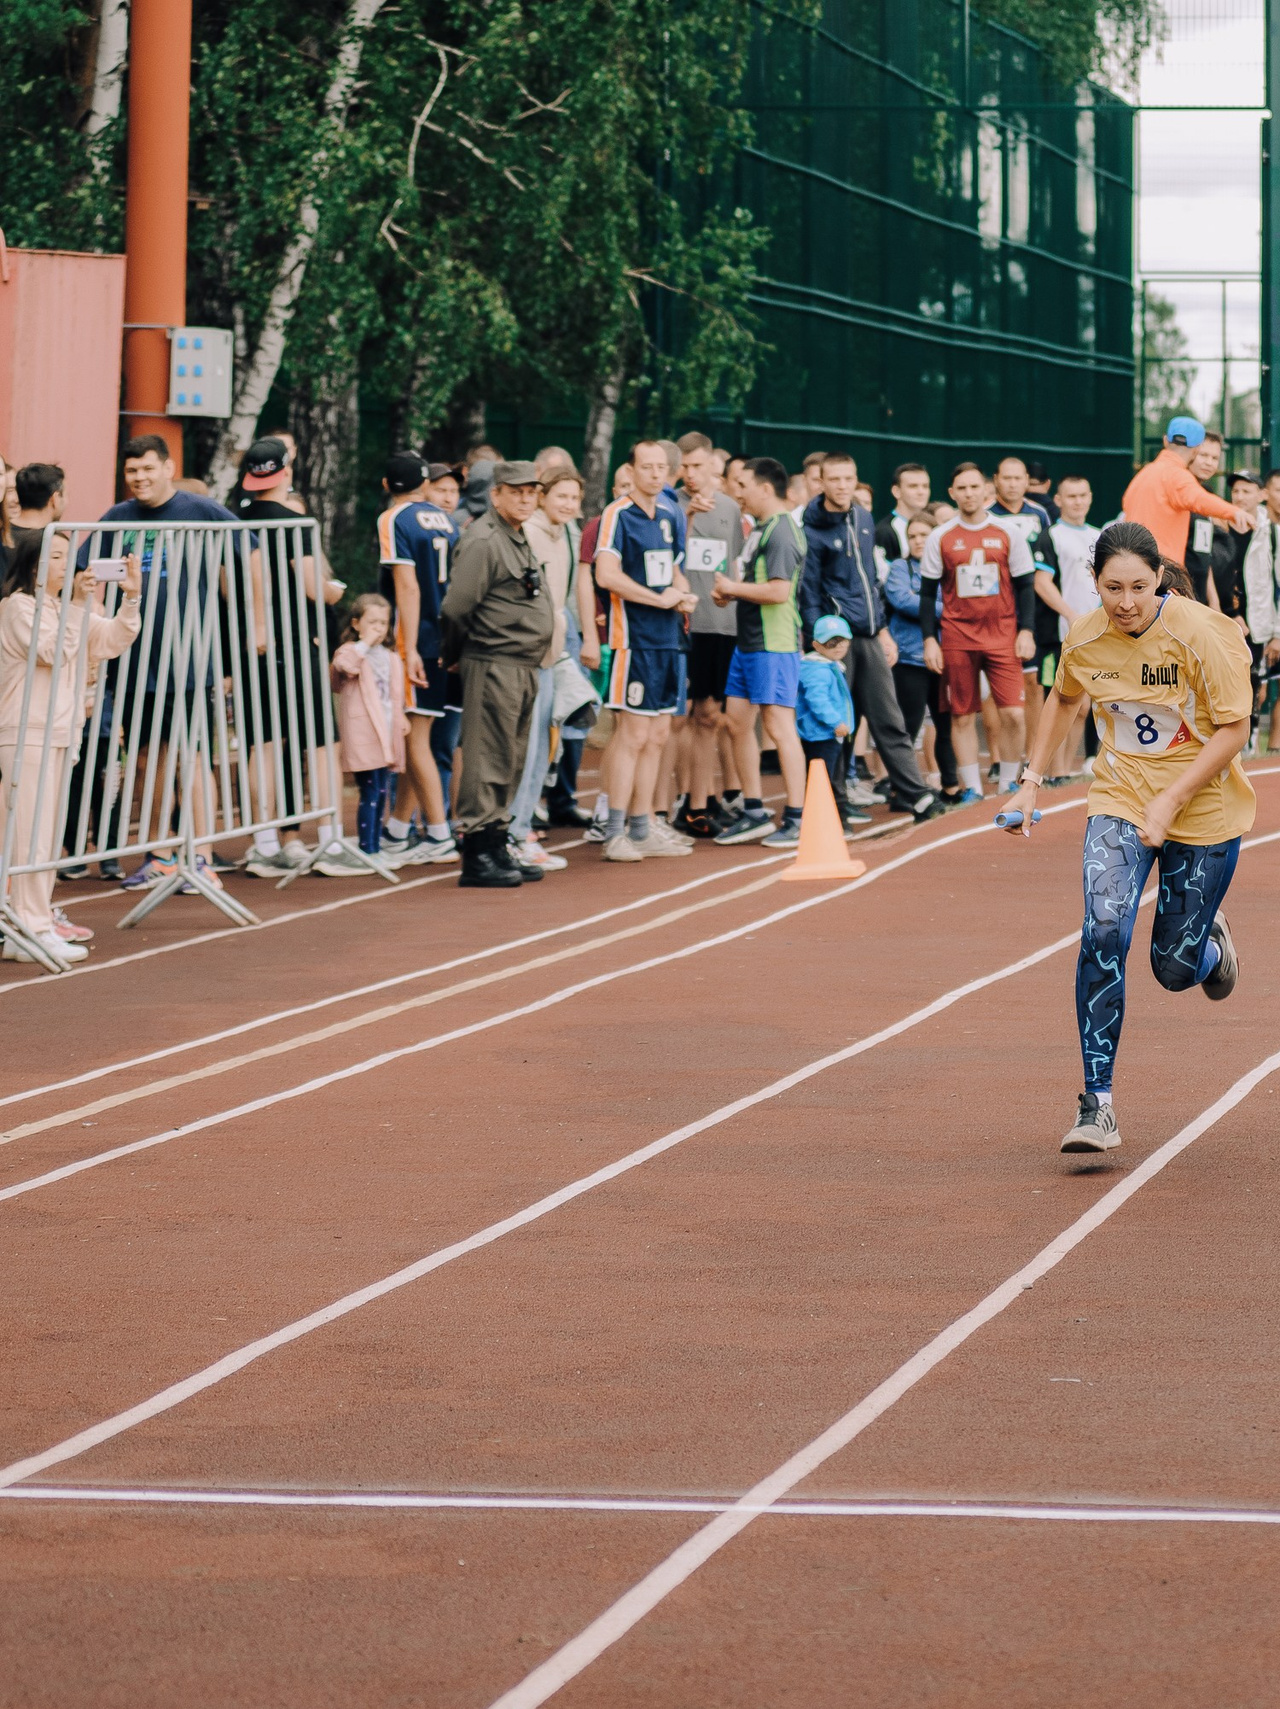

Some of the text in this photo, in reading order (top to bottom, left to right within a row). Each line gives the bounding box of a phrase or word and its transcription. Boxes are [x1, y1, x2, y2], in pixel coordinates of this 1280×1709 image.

[702, 549, 712, 566] 6
[659, 561, 666, 579] 7
[972, 574, 984, 590] 4
[1100, 671, 1120, 680] asics
[1134, 713, 1159, 746] 8
[1177, 731, 1186, 744] 5
